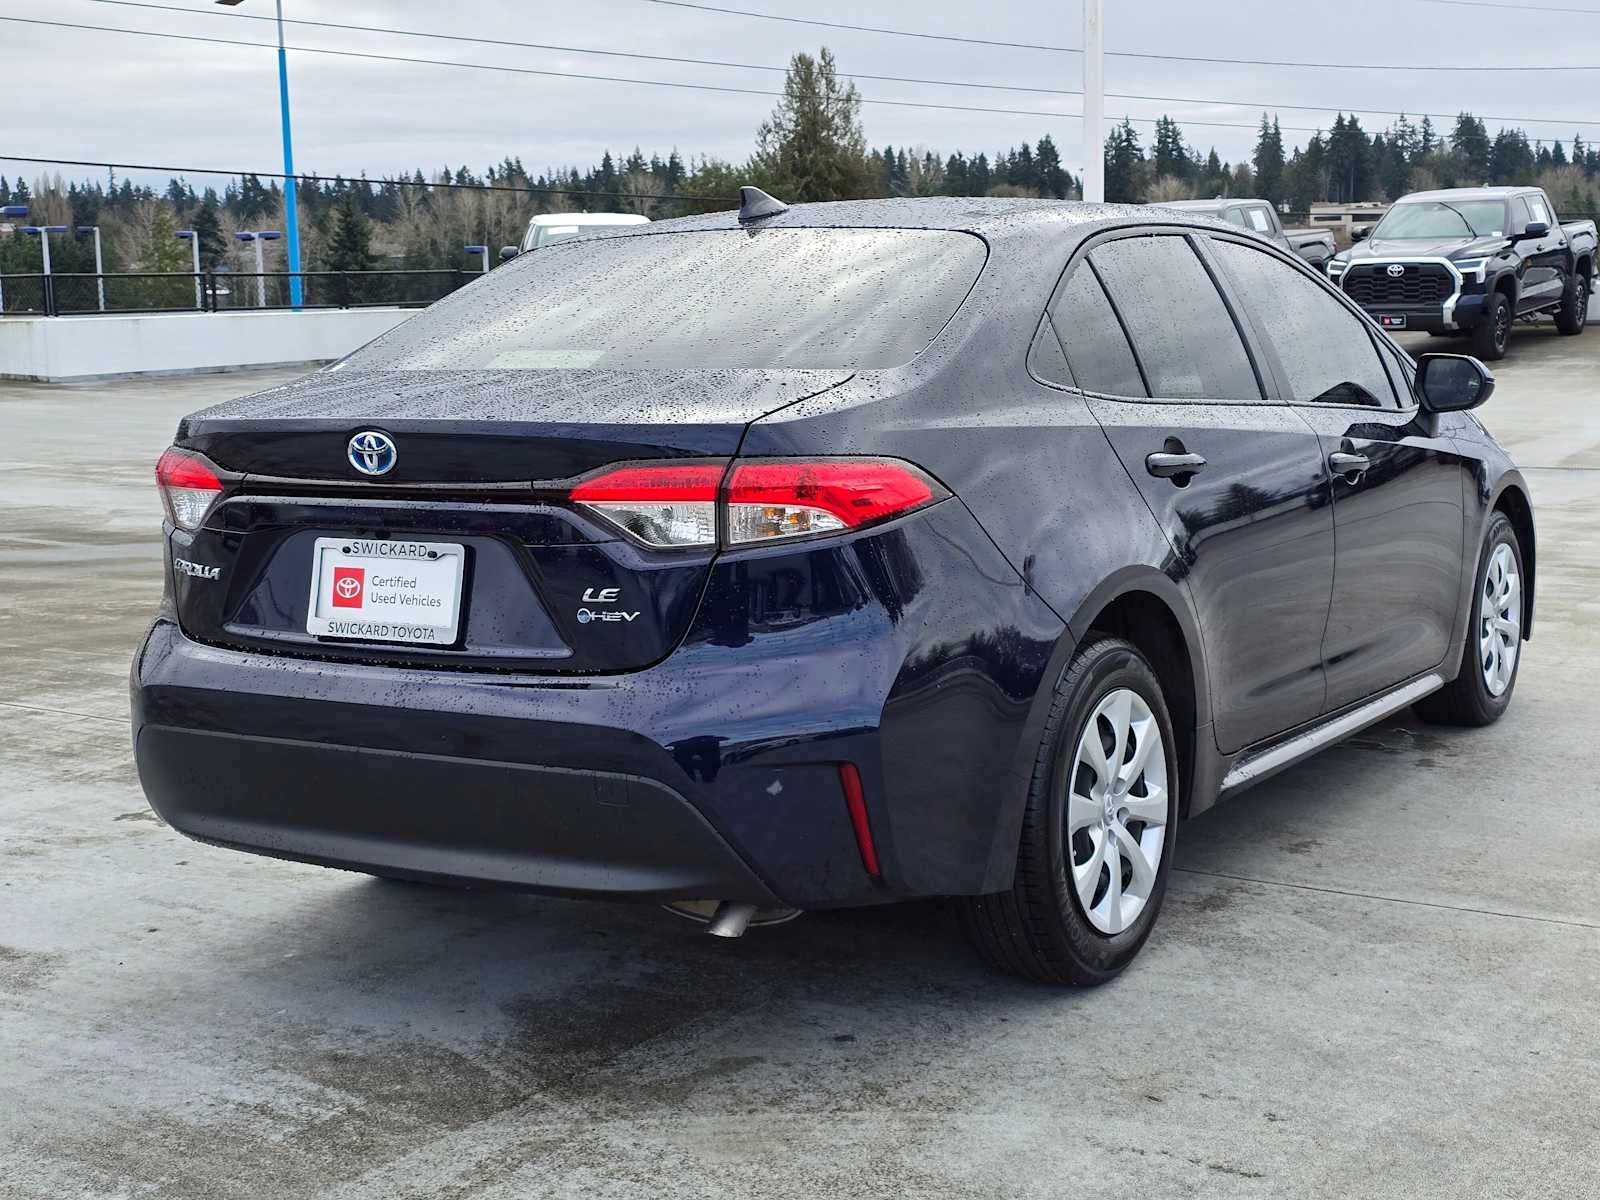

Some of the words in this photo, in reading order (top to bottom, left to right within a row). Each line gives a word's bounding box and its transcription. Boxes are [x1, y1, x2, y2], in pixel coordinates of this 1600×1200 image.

[352, 541, 428, 558] SWICKARD
[371, 575, 417, 589] Certified
[370, 592, 396, 605] Used
[399, 592, 442, 607] Vehicles
[582, 587, 621, 602] LE
[591, 611, 641, 622] HEV
[327, 621, 389, 637] SWICKARD
[392, 625, 435, 641] TOYOTA
